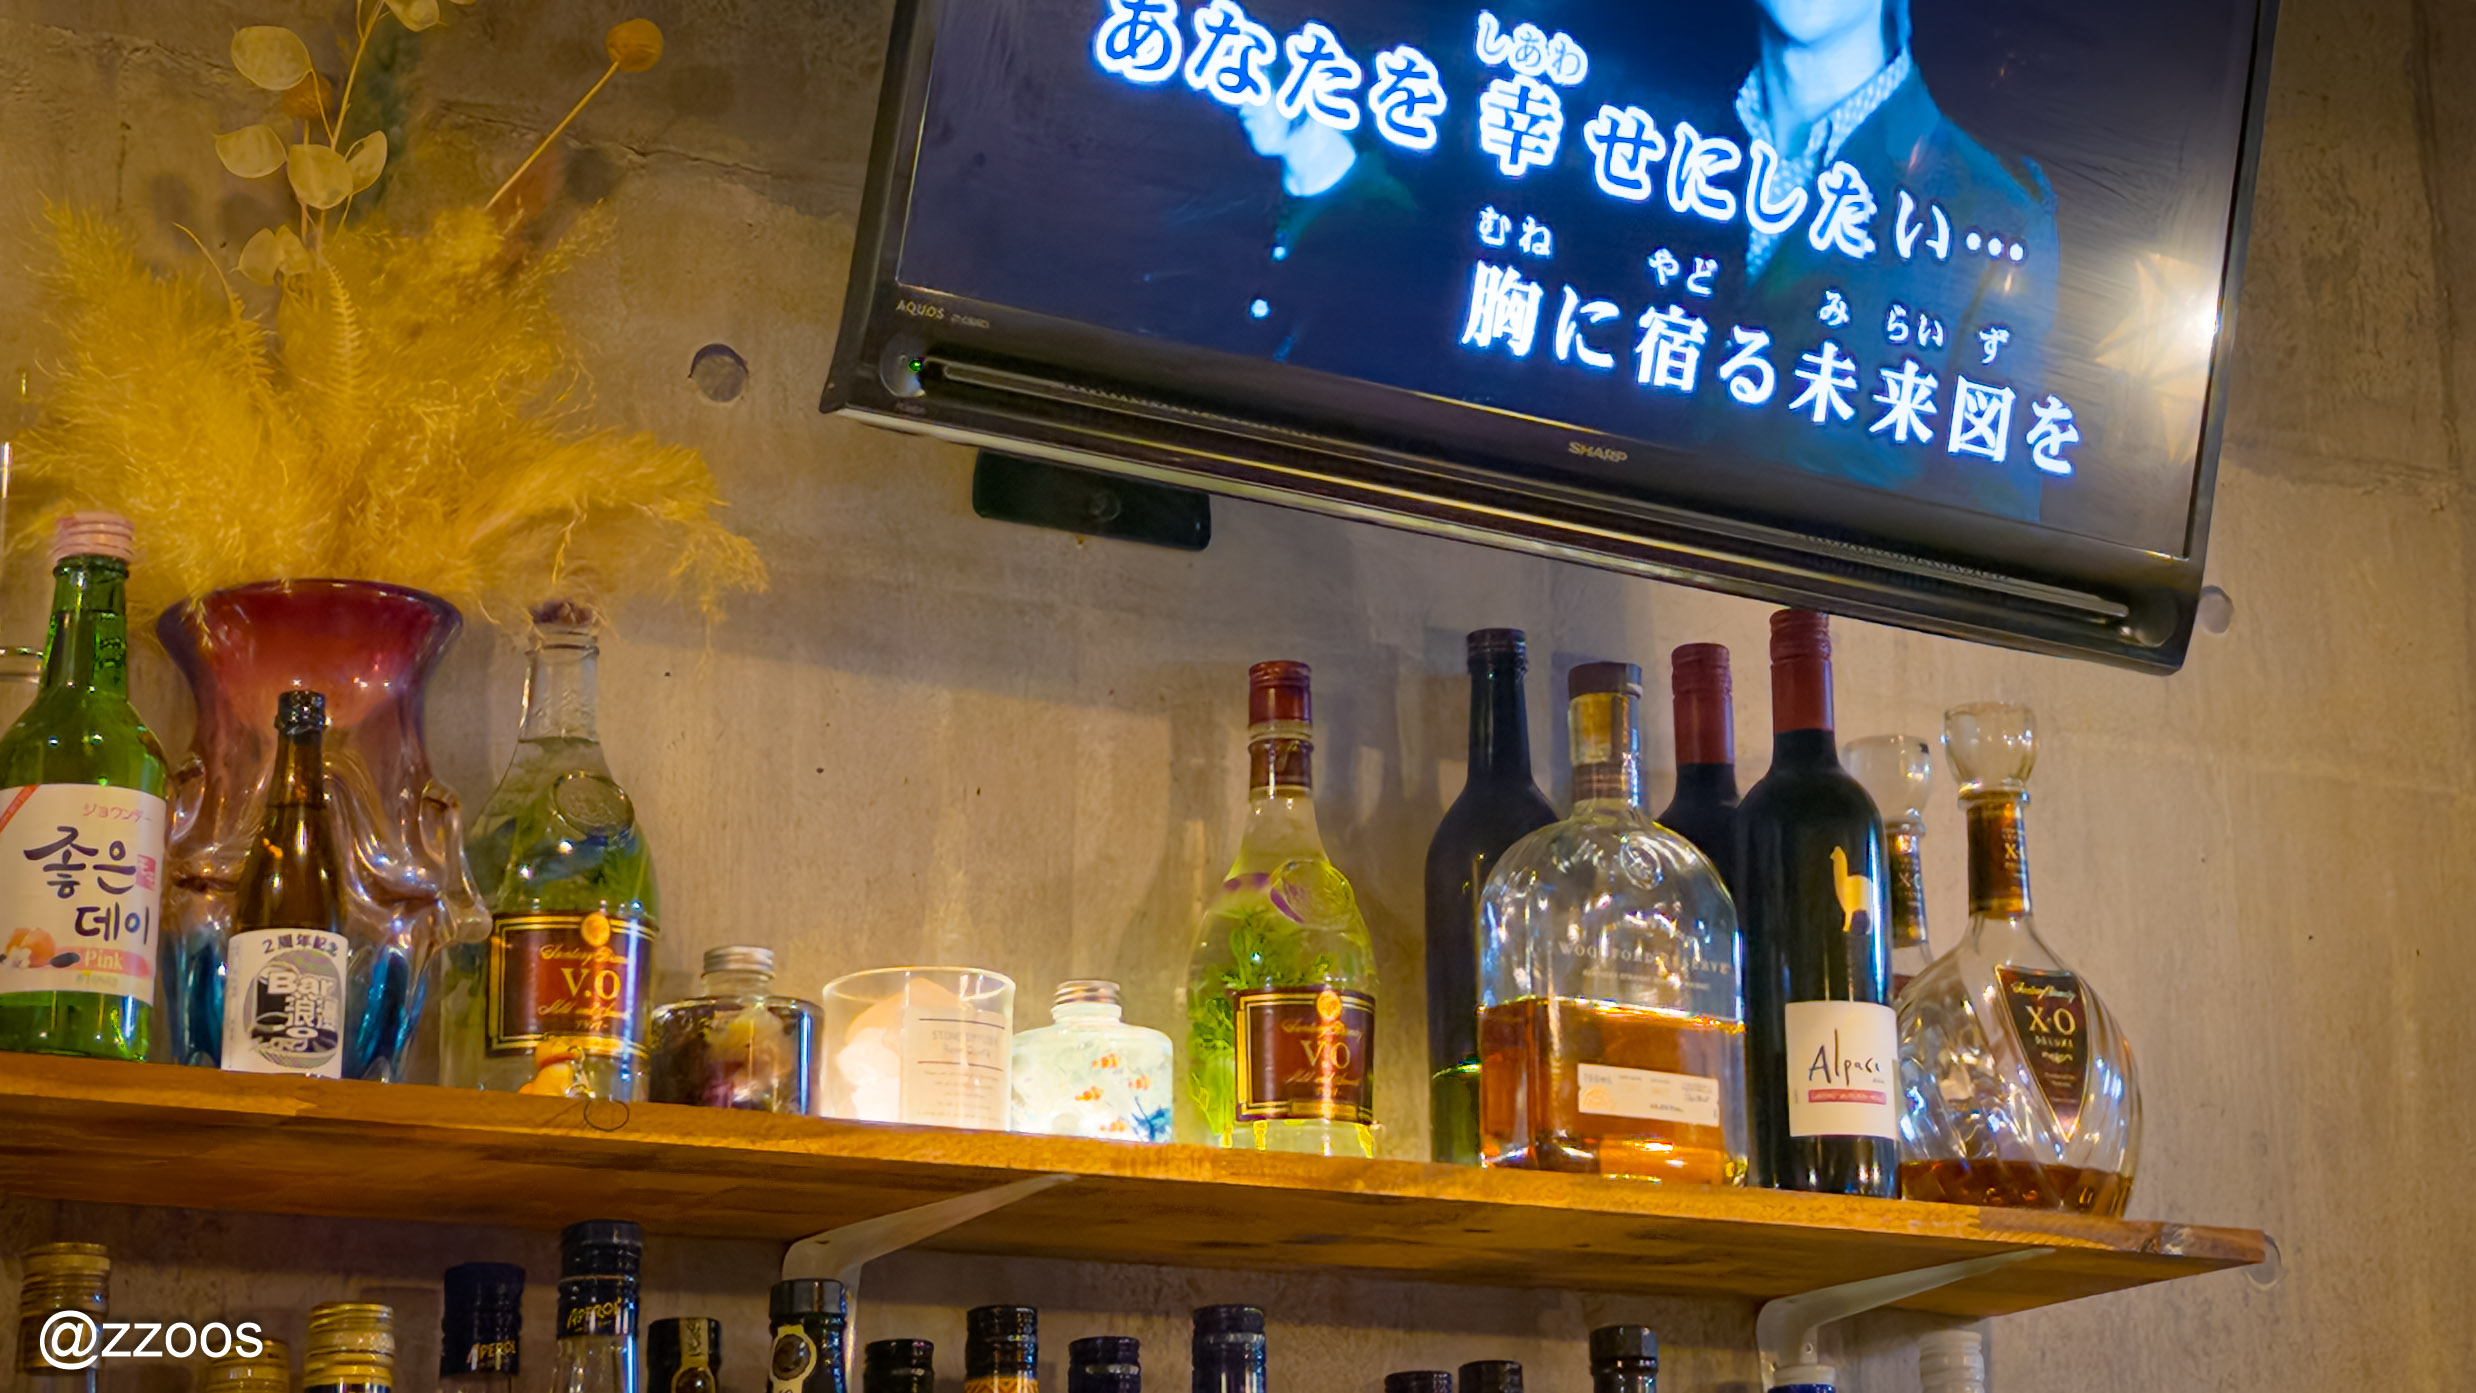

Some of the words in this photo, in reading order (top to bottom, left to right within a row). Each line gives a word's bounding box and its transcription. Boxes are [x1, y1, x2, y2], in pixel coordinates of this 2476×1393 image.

[1475, 9, 1588, 87] しあわ
[1477, 204, 1553, 259] むね
[1647, 247, 1718, 297] やど
[896, 299, 945, 320] AQUOS
[1817, 289, 1850, 328] み
[1886, 303, 1944, 349] らい
[1978, 326, 2010, 364] ず
[1460, 258, 2081, 477] 胸に宿る未来図を
[1568, 441, 1628, 463] SHARP
[23, 825, 137, 899] 좋은
[74, 901, 150, 946] 데이
[84, 950, 123, 970] Pink
[1558, 941, 1656, 963] WOOFORD
[267, 970, 337, 997] Bar
[561, 967, 621, 1000] V.O
